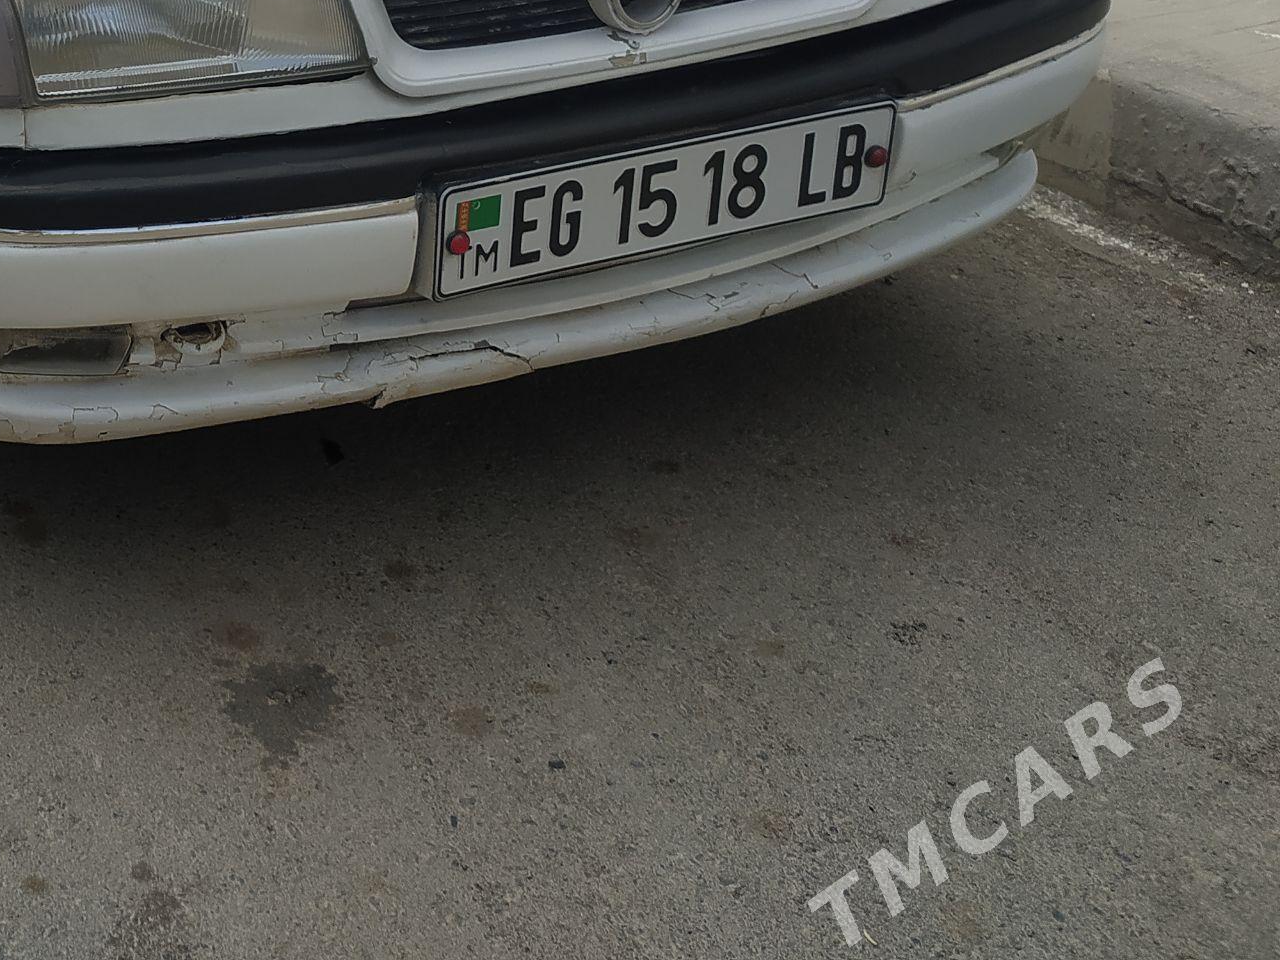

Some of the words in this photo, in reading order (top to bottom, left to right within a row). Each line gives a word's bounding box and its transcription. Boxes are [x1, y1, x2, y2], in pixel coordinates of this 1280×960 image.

[509, 179, 584, 268] EG
[613, 158, 678, 245] 15
[703, 143, 768, 227] 18
[798, 123, 867, 208] LB
